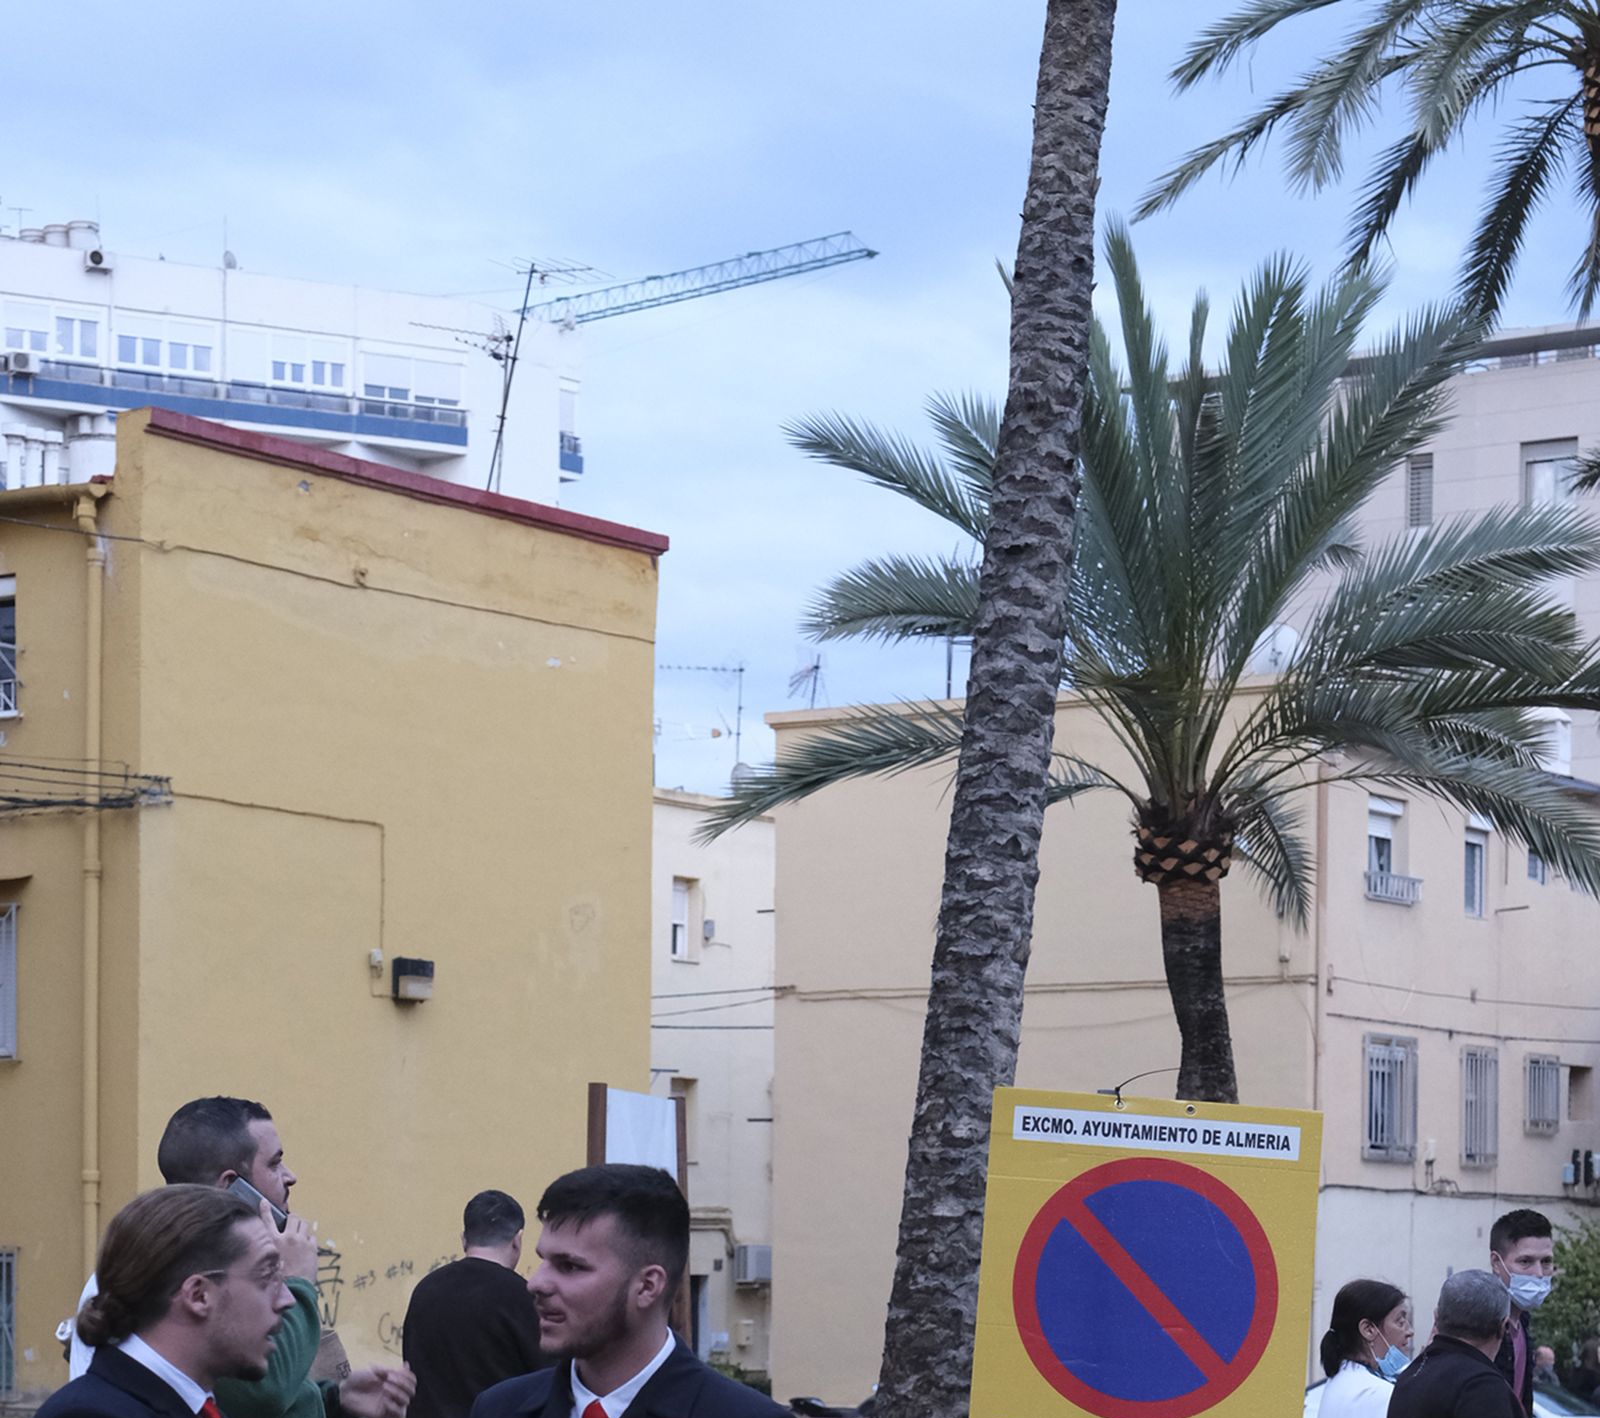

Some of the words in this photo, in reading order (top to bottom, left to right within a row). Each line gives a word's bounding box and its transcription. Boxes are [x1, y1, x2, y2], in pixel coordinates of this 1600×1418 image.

[1022, 1115, 1077, 1135] EXCMO.
[1081, 1120, 1198, 1144] AYUNTAMIENTO
[1202, 1129, 1221, 1146] DE
[1225, 1131, 1291, 1151] ALMERIA
